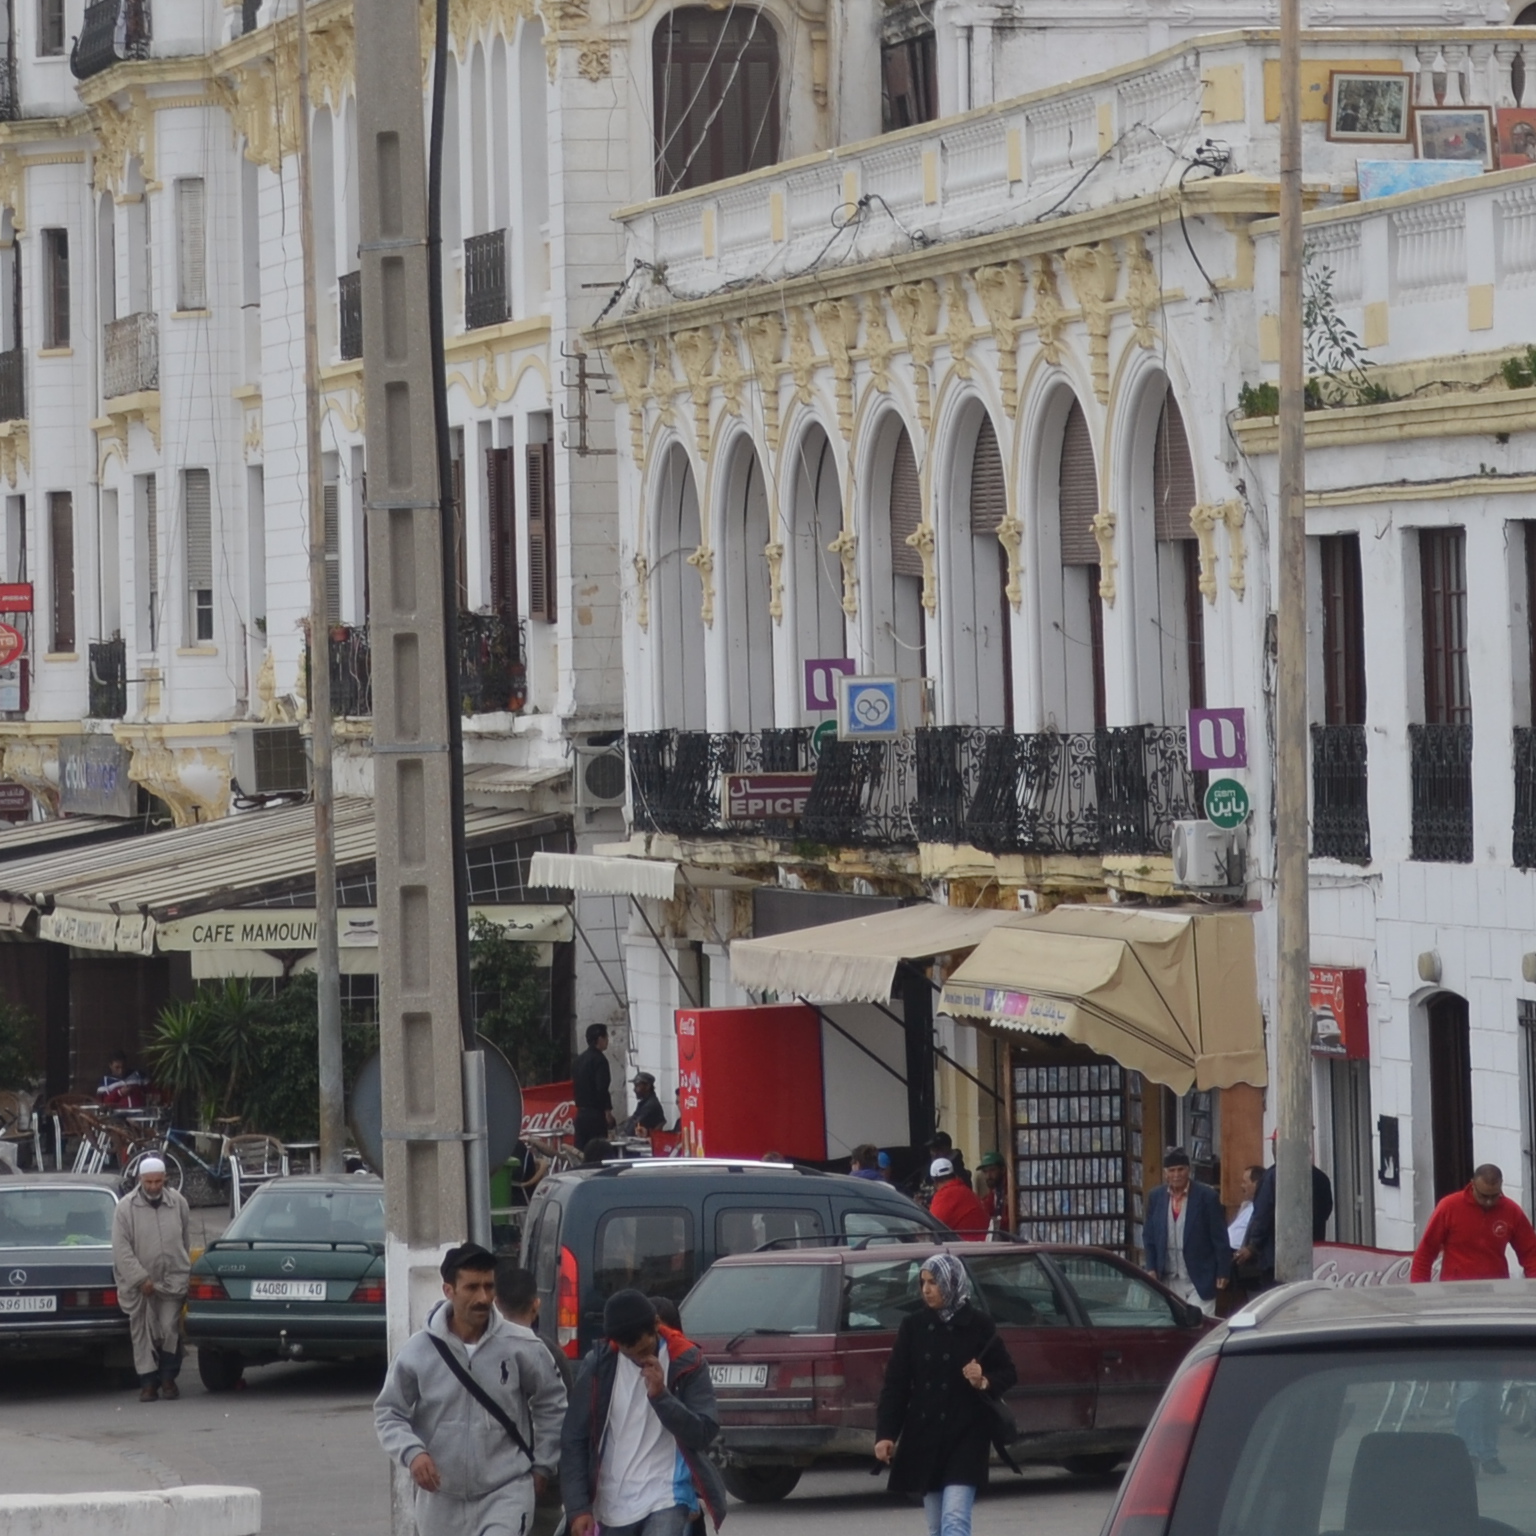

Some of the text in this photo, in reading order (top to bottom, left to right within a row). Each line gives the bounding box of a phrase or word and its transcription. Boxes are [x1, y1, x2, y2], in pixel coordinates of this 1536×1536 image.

[729, 797, 807, 815] EPICE
[192, 922, 317, 943] CAFE MAMOUNI
[255, 1282, 288, 1295] 44080
[308, 1283, 323, 1295] 40
[38, 1298, 53, 1308] 50
[754, 1366, 766, 1382] 40
